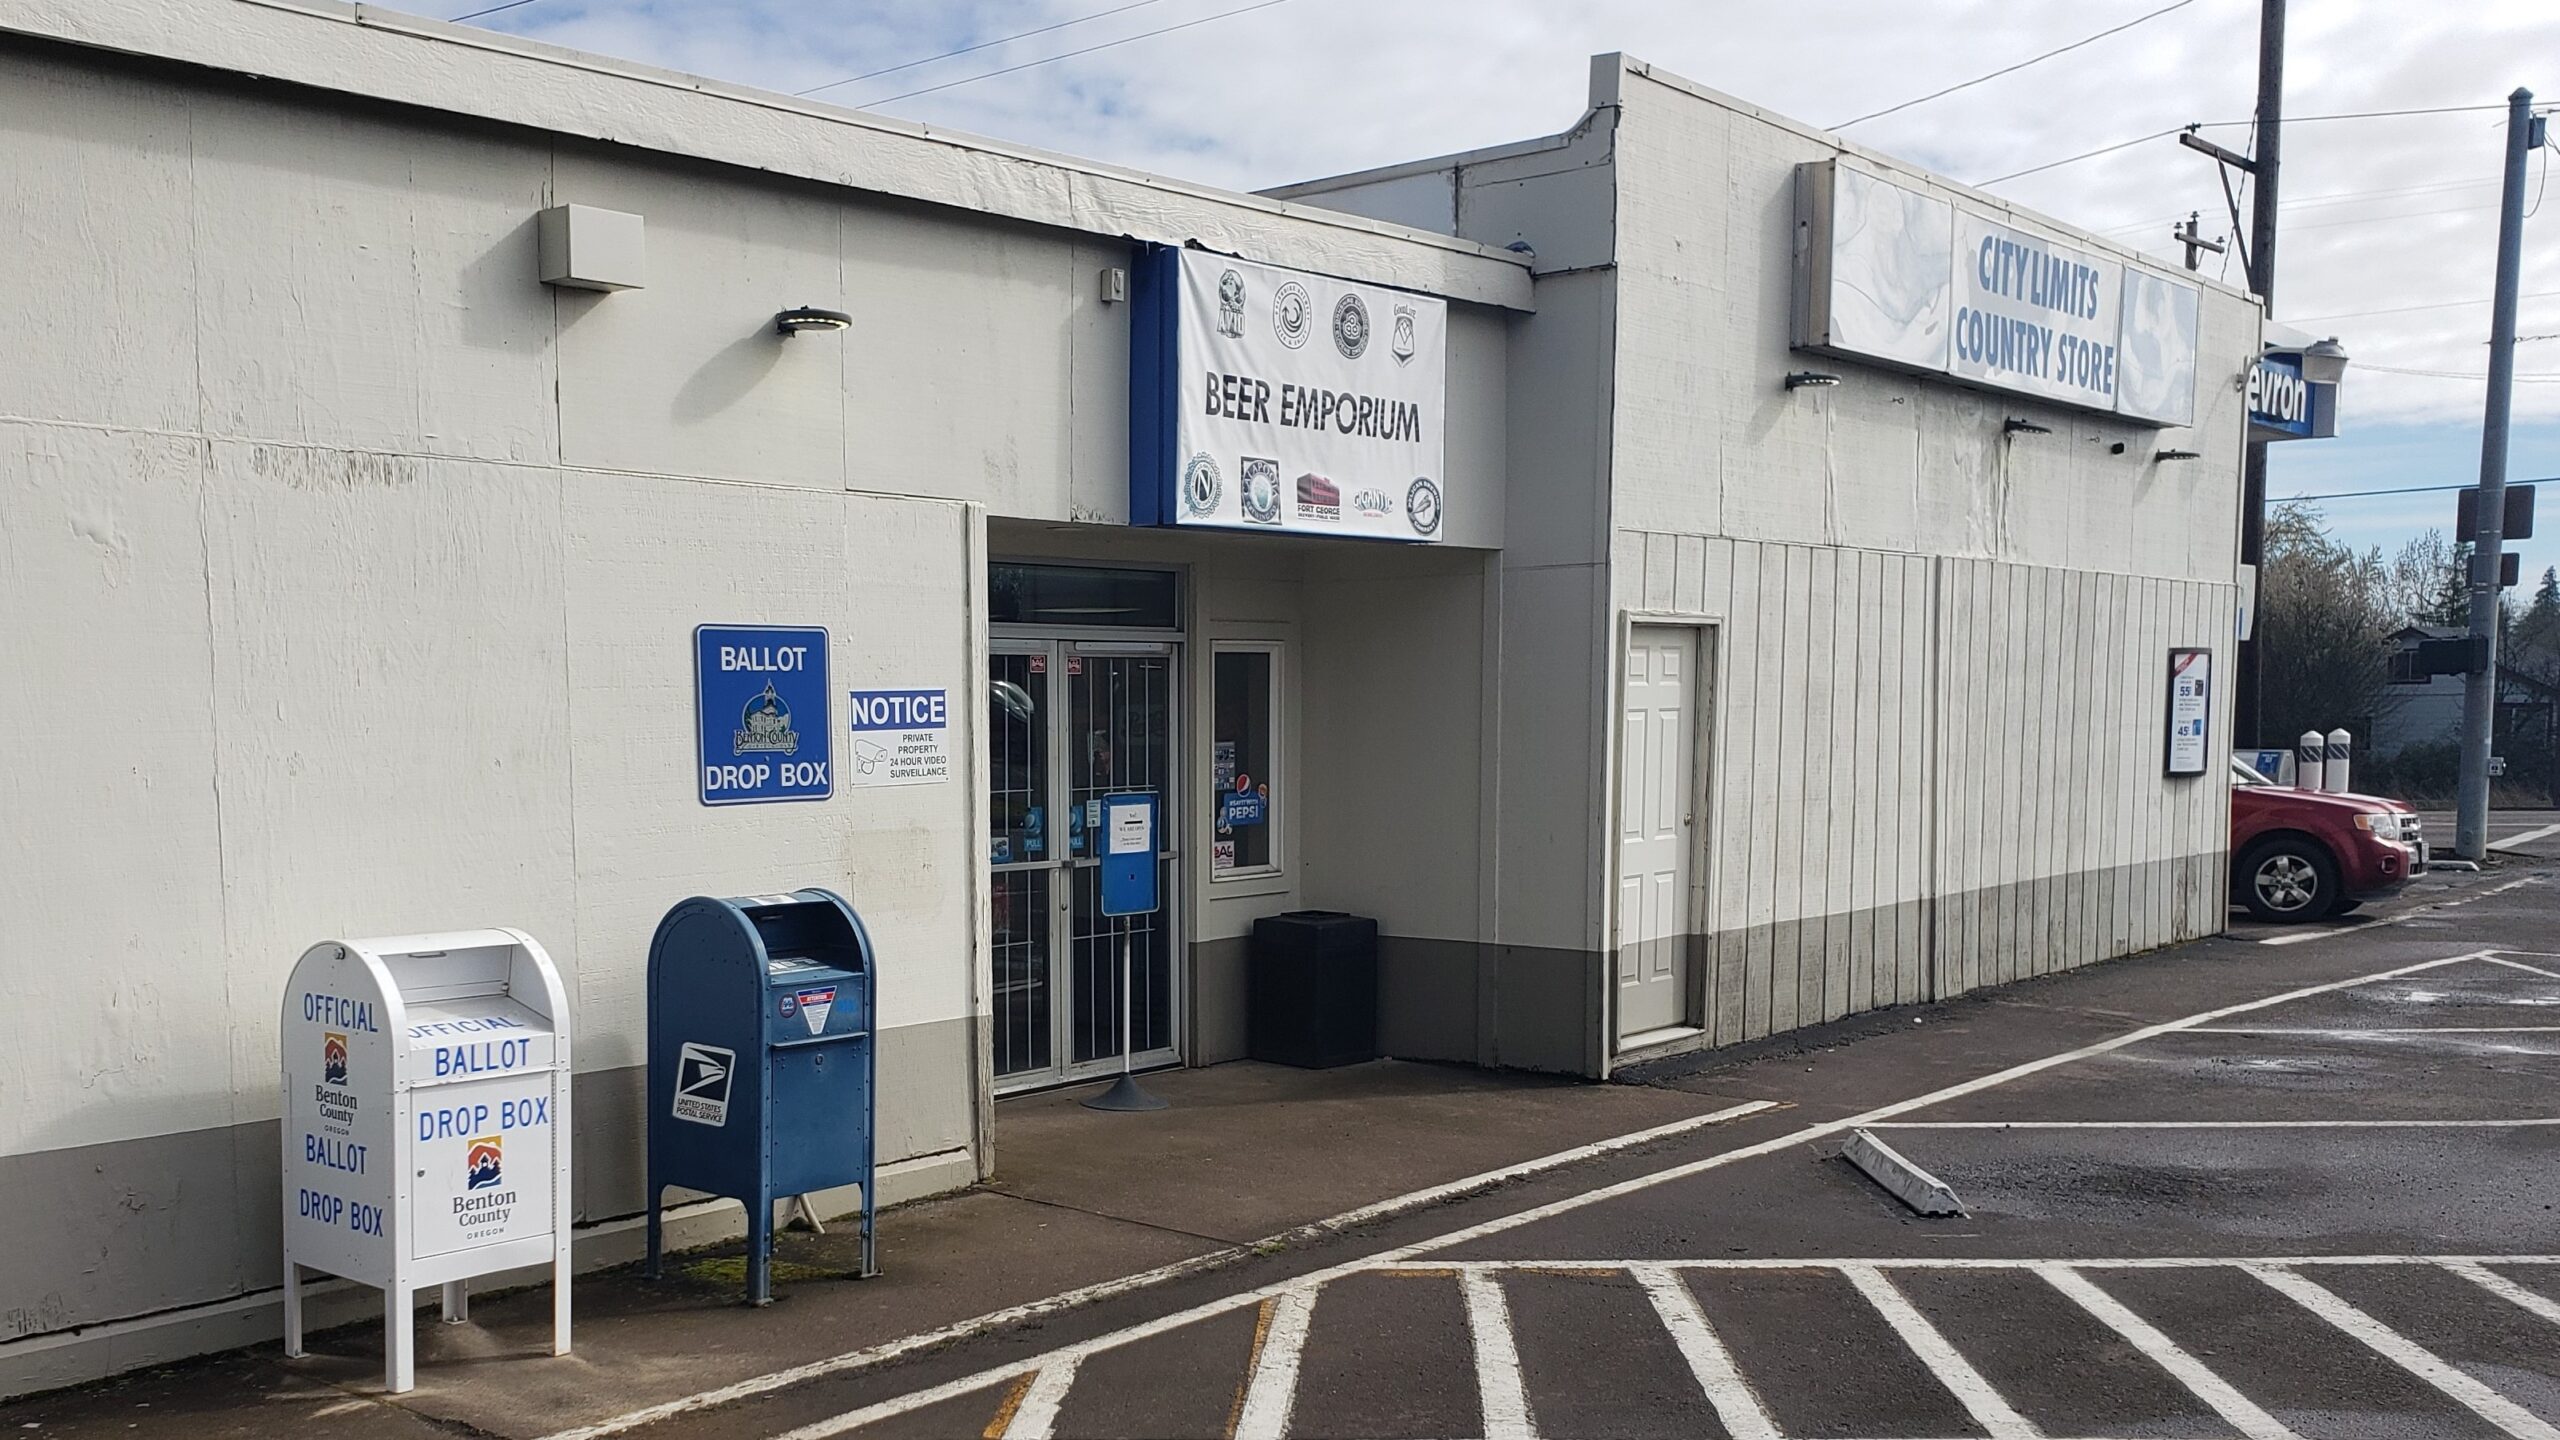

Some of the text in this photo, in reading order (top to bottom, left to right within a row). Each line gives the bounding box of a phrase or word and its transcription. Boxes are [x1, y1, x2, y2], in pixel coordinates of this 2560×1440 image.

[1979, 235, 2099, 321] CITY LIMITS
[1956, 306, 2114, 395] COUNTRY STORE
[1205, 371, 1421, 443] BEER EMPORIUM
[1297, 504, 1341, 516] FORT GEORGE
[720, 646, 808, 672] BALLOT
[852, 695, 945, 725] NOTICE
[898, 744, 939, 754] PROPERTY
[902, 733, 934, 743] PRIVATE
[890, 756, 947, 767] 24 HOUR VIDEO
[890, 767, 947, 779] SURVEILLANCE
[706, 762, 829, 790] DROP BOX
[1229, 805, 1259, 820] PEPSI
[1026, 839, 1041, 848] PULL
[303, 992, 379, 1033] OFFICIAL
[435, 1038, 531, 1077] BALLOT
[315, 1084, 358, 1110] Benton
[677, 1097, 722, 1113] UNITED STATES
[319, 1103, 354, 1127] County
[419, 1096, 549, 1141] DROP BOX
[676, 1106, 723, 1123] POSTAL SERVICE
[324, 1125, 350, 1136] OREGON
[306, 1133, 367, 1175] BALLOT
[300, 1188, 383, 1238] DROP BOX
[452, 1191, 517, 1214] Benton
[458, 1208, 511, 1227] County
[466, 1227, 505, 1240] OREGON
